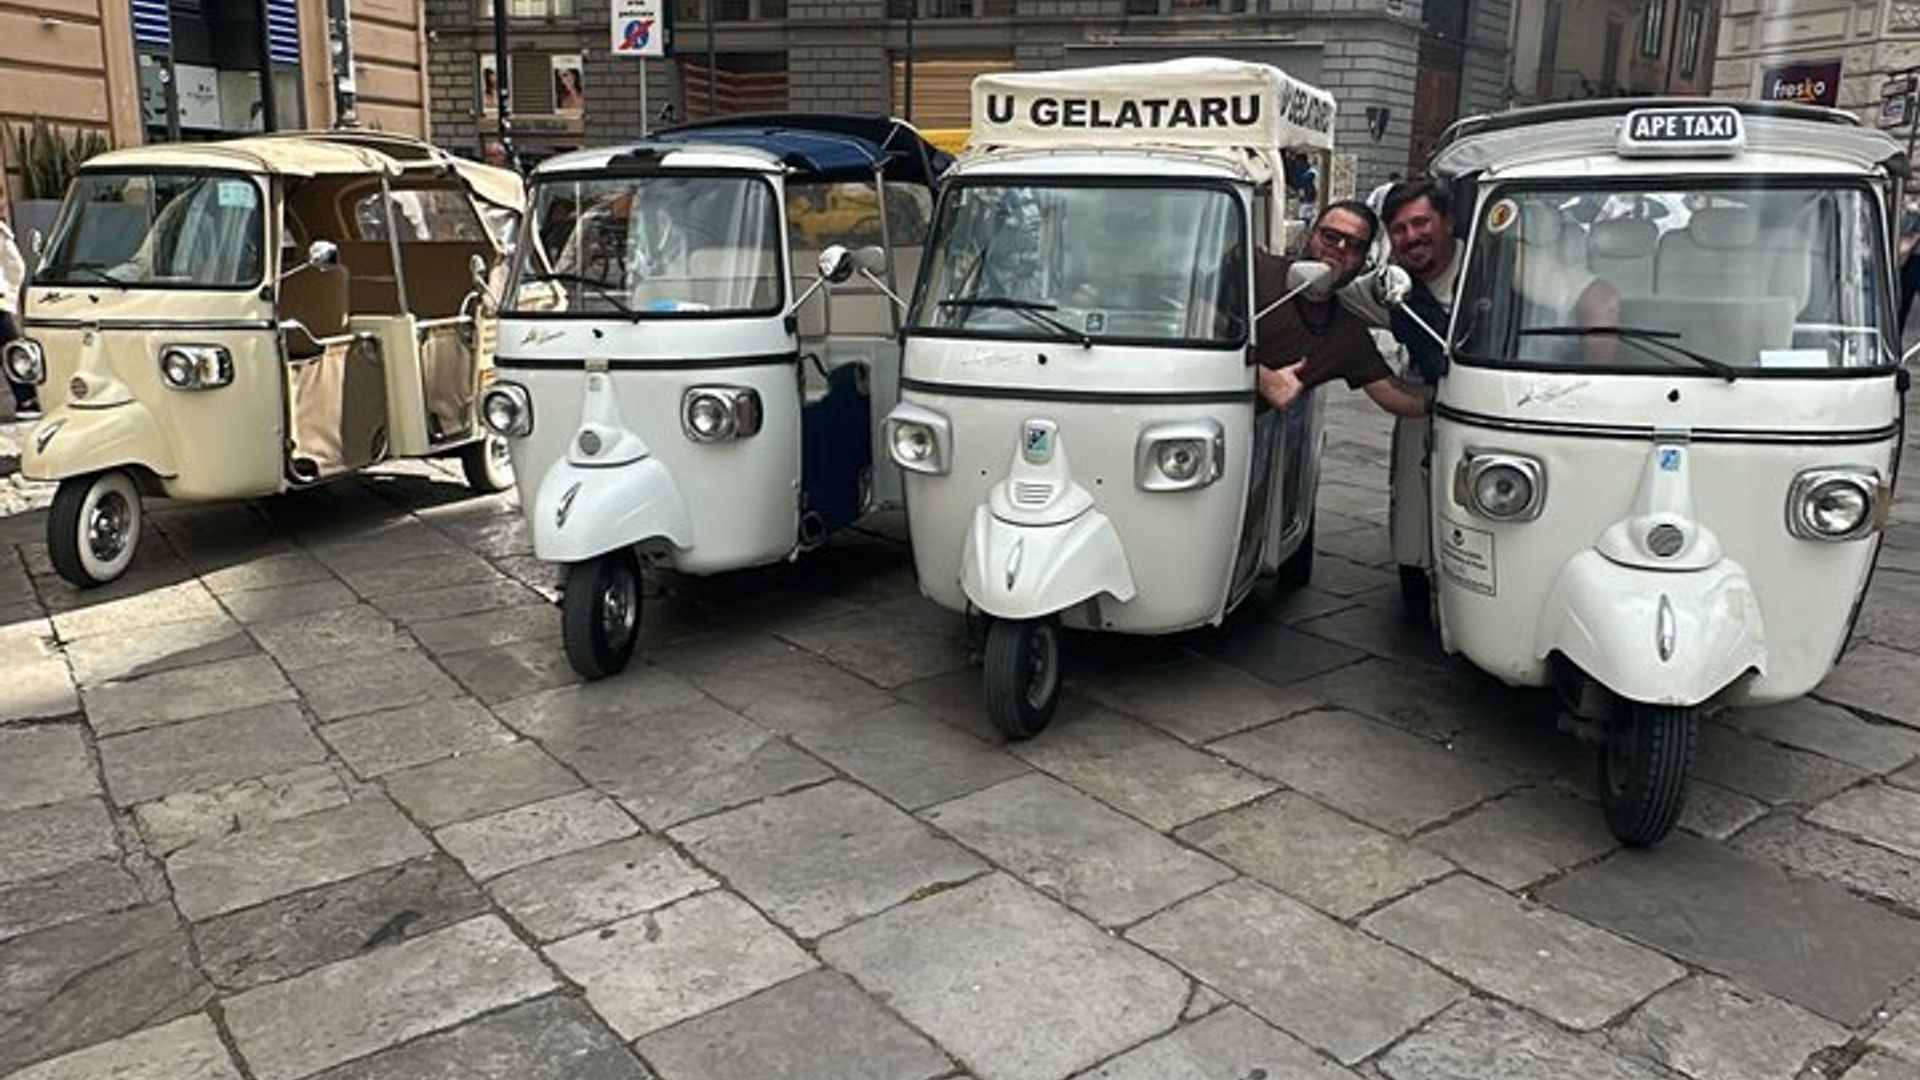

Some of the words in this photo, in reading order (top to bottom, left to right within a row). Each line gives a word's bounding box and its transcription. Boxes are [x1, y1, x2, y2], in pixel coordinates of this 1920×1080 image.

[986, 95, 1015, 124] U
[1029, 94, 1260, 128] GELATARU
[1634, 115, 1677, 137] APE
[1682, 115, 1732, 136] TAXI
